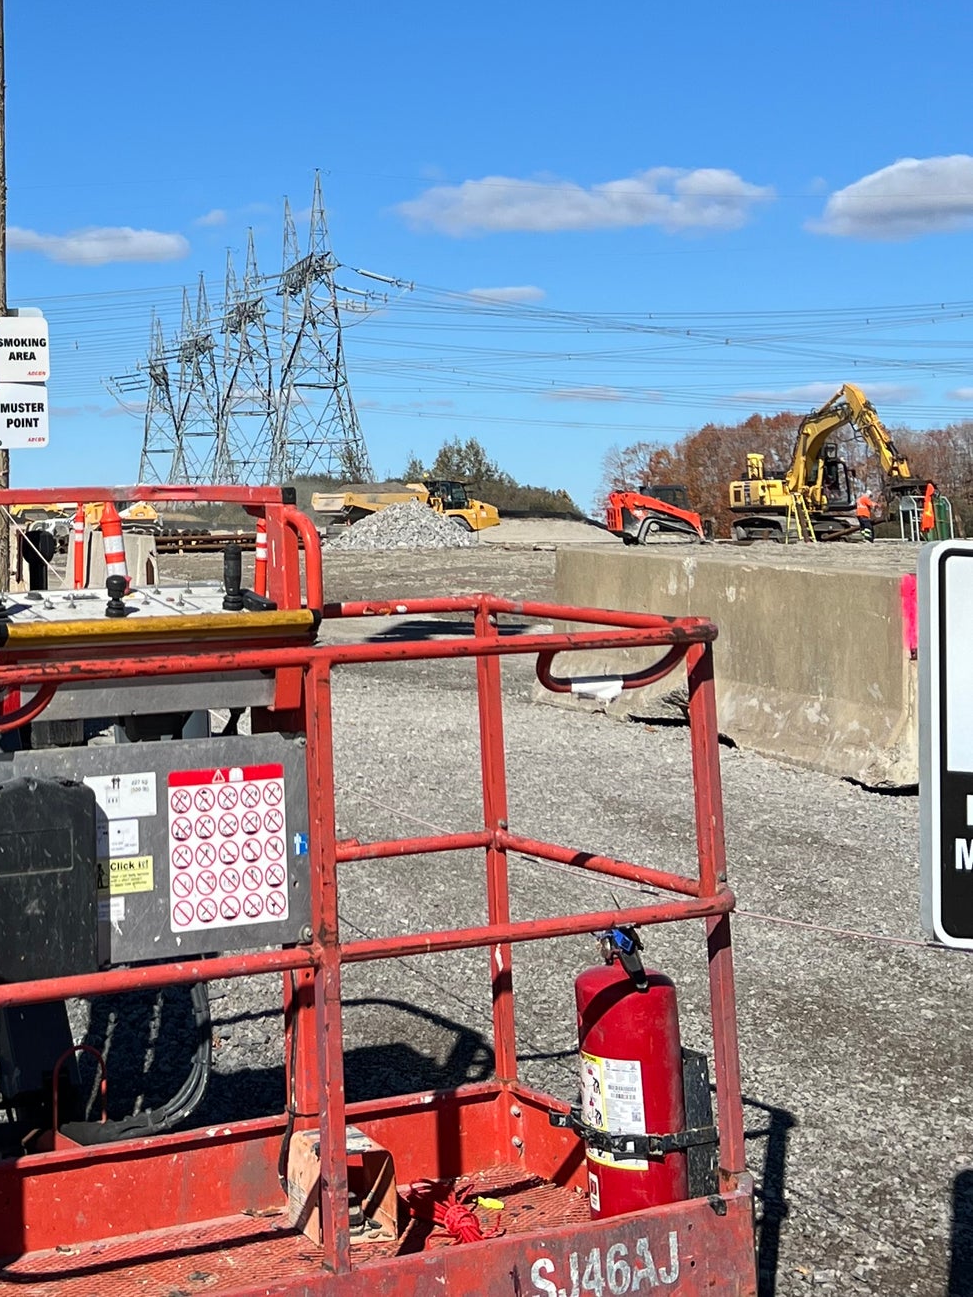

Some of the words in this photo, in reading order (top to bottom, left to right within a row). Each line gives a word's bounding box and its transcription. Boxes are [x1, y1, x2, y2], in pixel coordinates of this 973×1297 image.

[8, 352, 36, 361] AREA
[0, 402, 44, 413] MUSTER
[7, 418, 39, 428] POINT
[110, 861, 135, 871] Click
[530, 1231, 679, 1297] SJ46AJ
